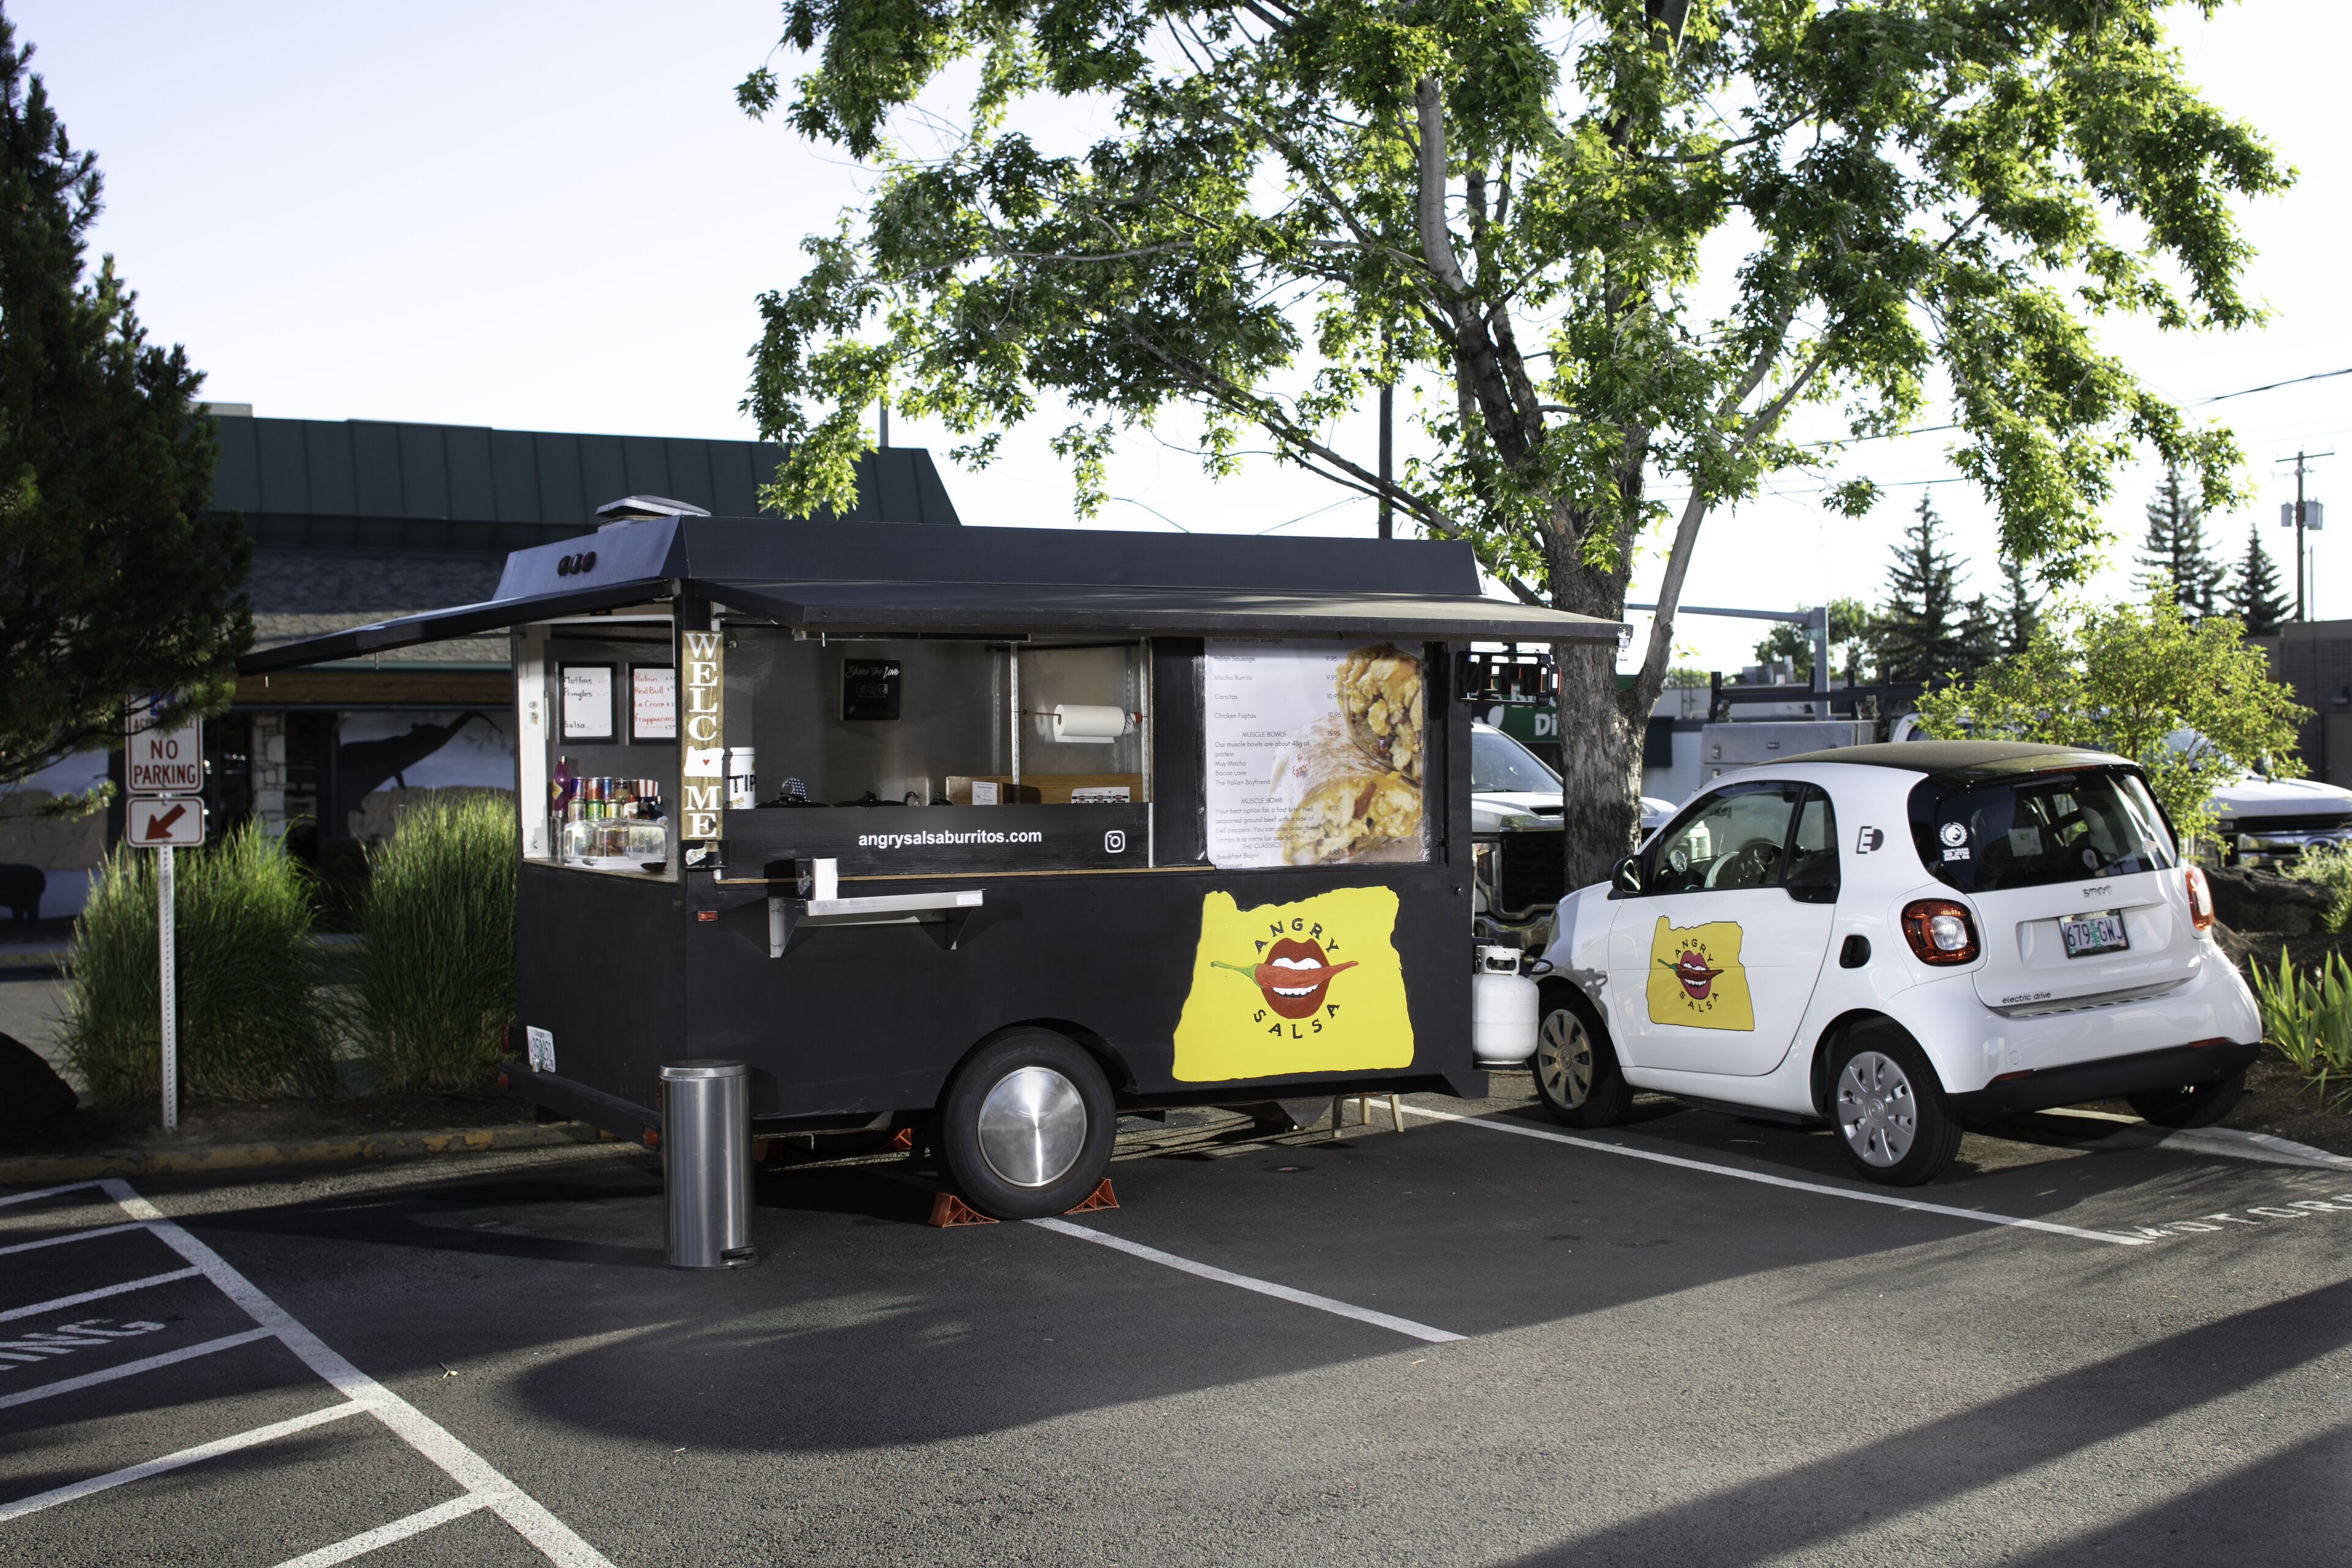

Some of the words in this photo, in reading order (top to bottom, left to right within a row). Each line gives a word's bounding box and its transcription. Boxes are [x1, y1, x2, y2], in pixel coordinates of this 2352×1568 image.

[564, 676, 593, 685] Muffins
[635, 673, 658, 682] Protein
[883, 666, 900, 679] Love
[564, 687, 593, 701] Pringles
[151, 739, 178, 760] NO
[134, 764, 196, 785] PARKING
[1243, 816, 1263, 824] ground
[859, 829, 1042, 849] angrysalsaburritos.com
[1254, 918, 1340, 956] ANGRY
[2067, 923, 2091, 948] 679
[2097, 918, 2124, 942] GWJ
[1675, 938, 1714, 959] ANGRY
[1679, 991, 1719, 1012] SALSA
[2002, 993, 2032, 1004] electric
[2033, 991, 2051, 1000] drive
[1253, 1003, 1341, 1040] SALSA
